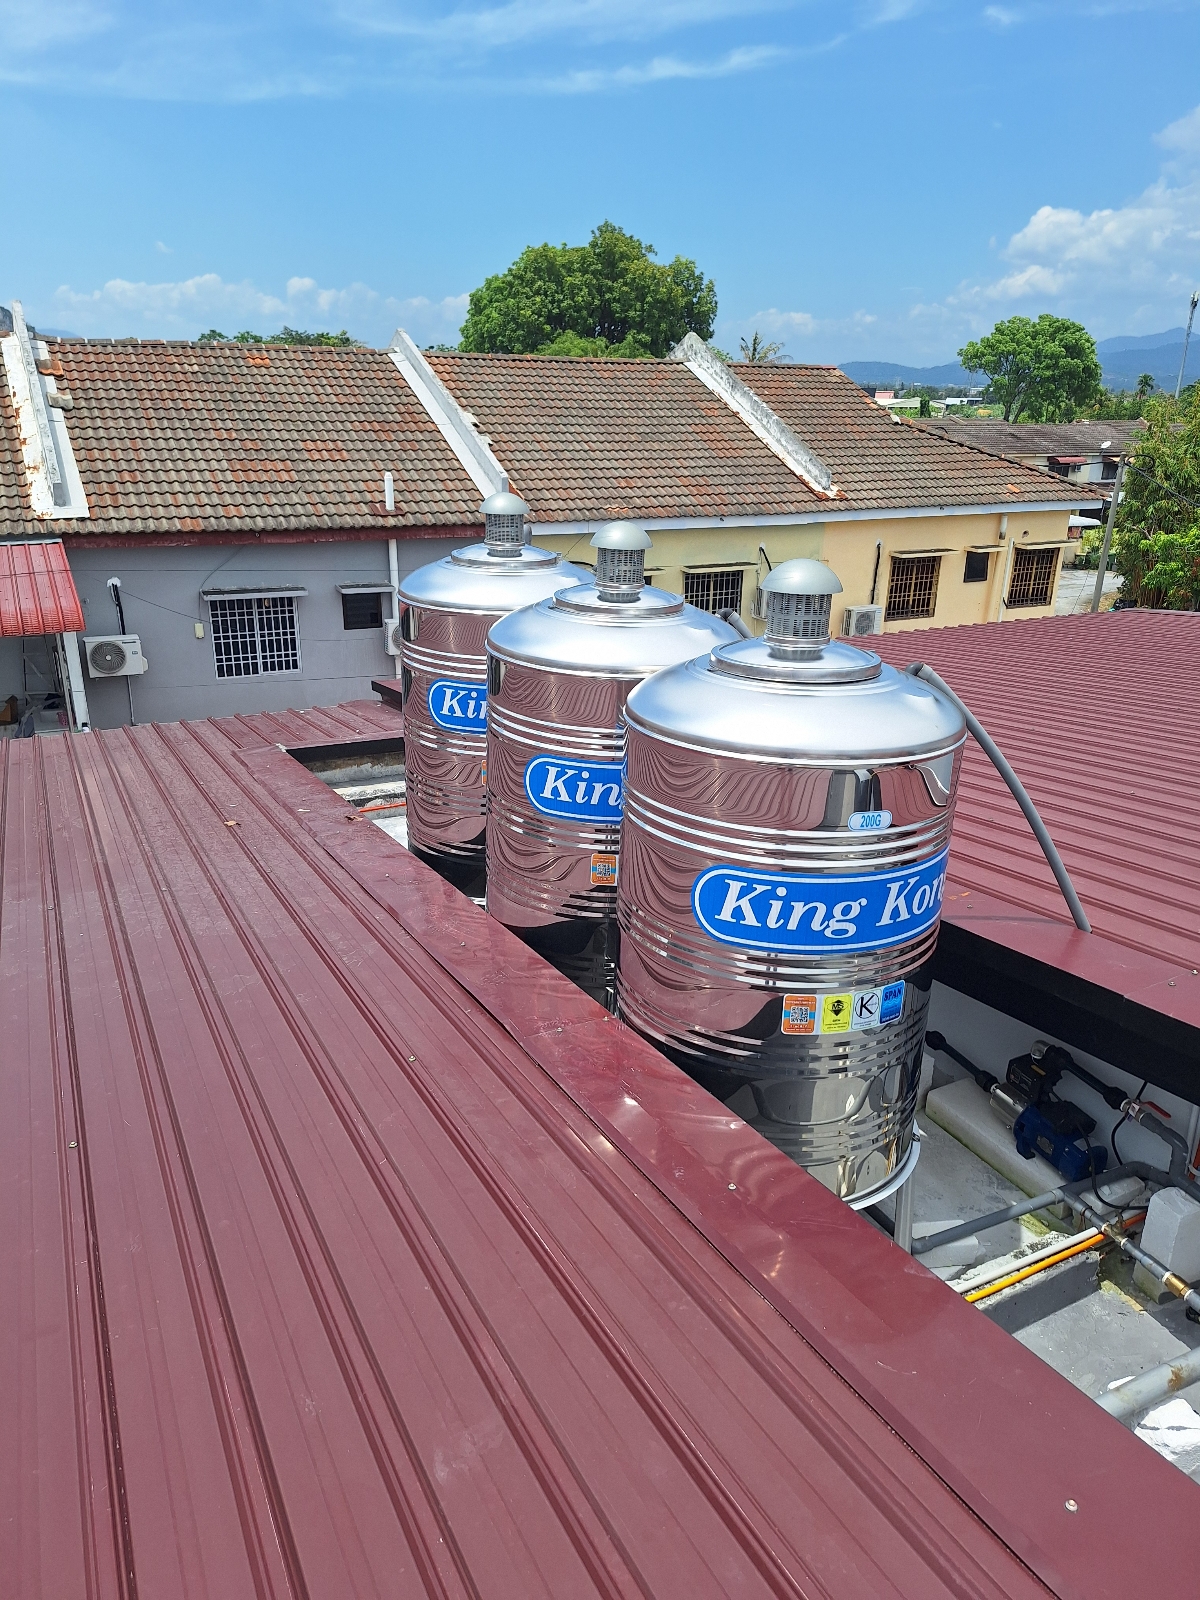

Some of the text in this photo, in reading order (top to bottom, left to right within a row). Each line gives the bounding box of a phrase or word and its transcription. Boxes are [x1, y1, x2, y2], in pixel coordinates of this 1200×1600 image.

[540, 765, 622, 809] Kin
[860, 814, 882, 828] 200G
[714, 872, 947, 939] King Kon
